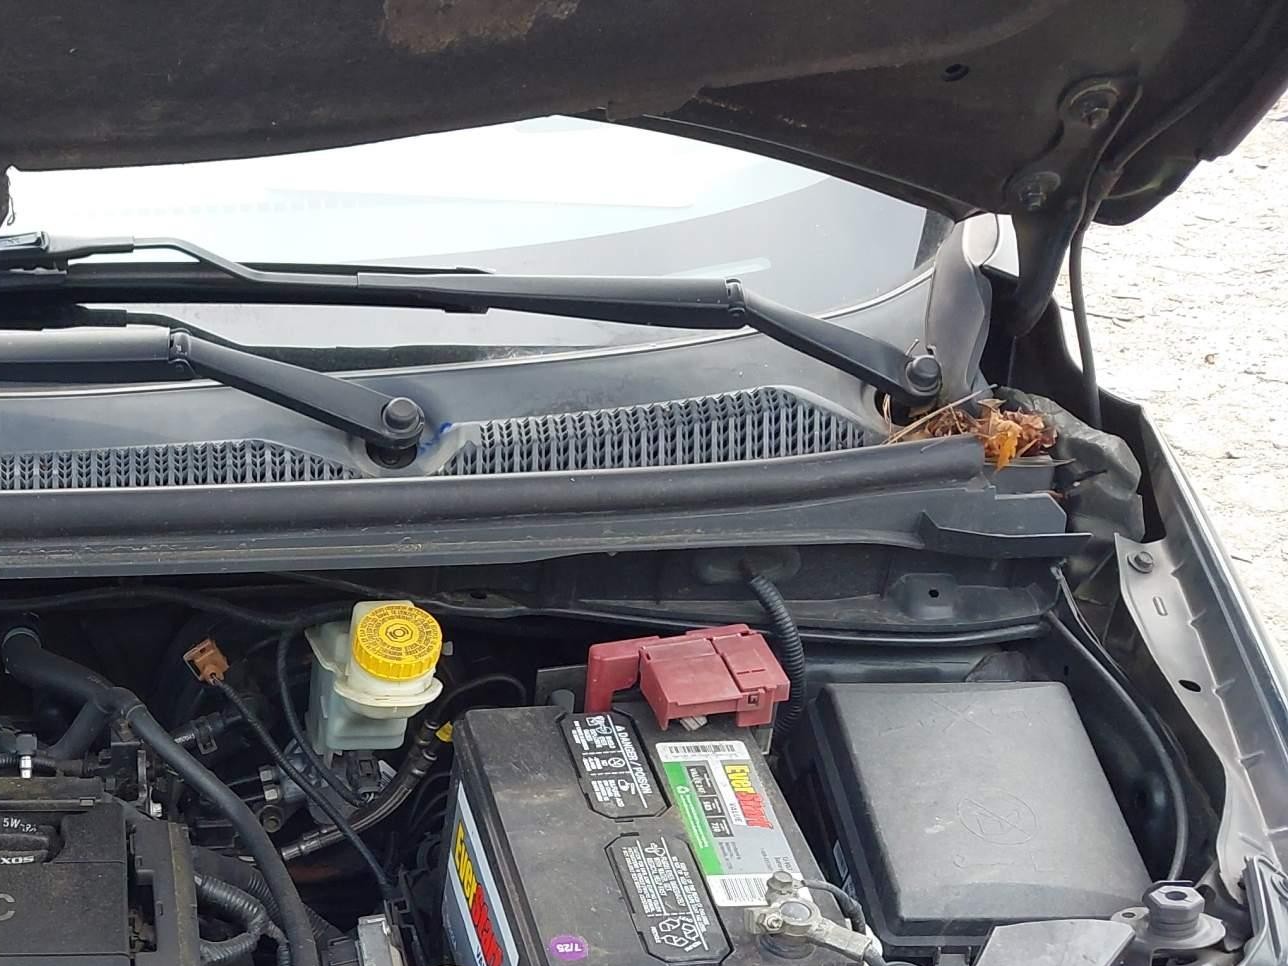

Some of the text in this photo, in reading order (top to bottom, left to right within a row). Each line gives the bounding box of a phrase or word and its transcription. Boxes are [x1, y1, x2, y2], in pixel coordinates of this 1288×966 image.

[619, 732, 638, 761] DANGER
[633, 767, 653, 794] POISON
[724, 765, 774, 829] EverStart
